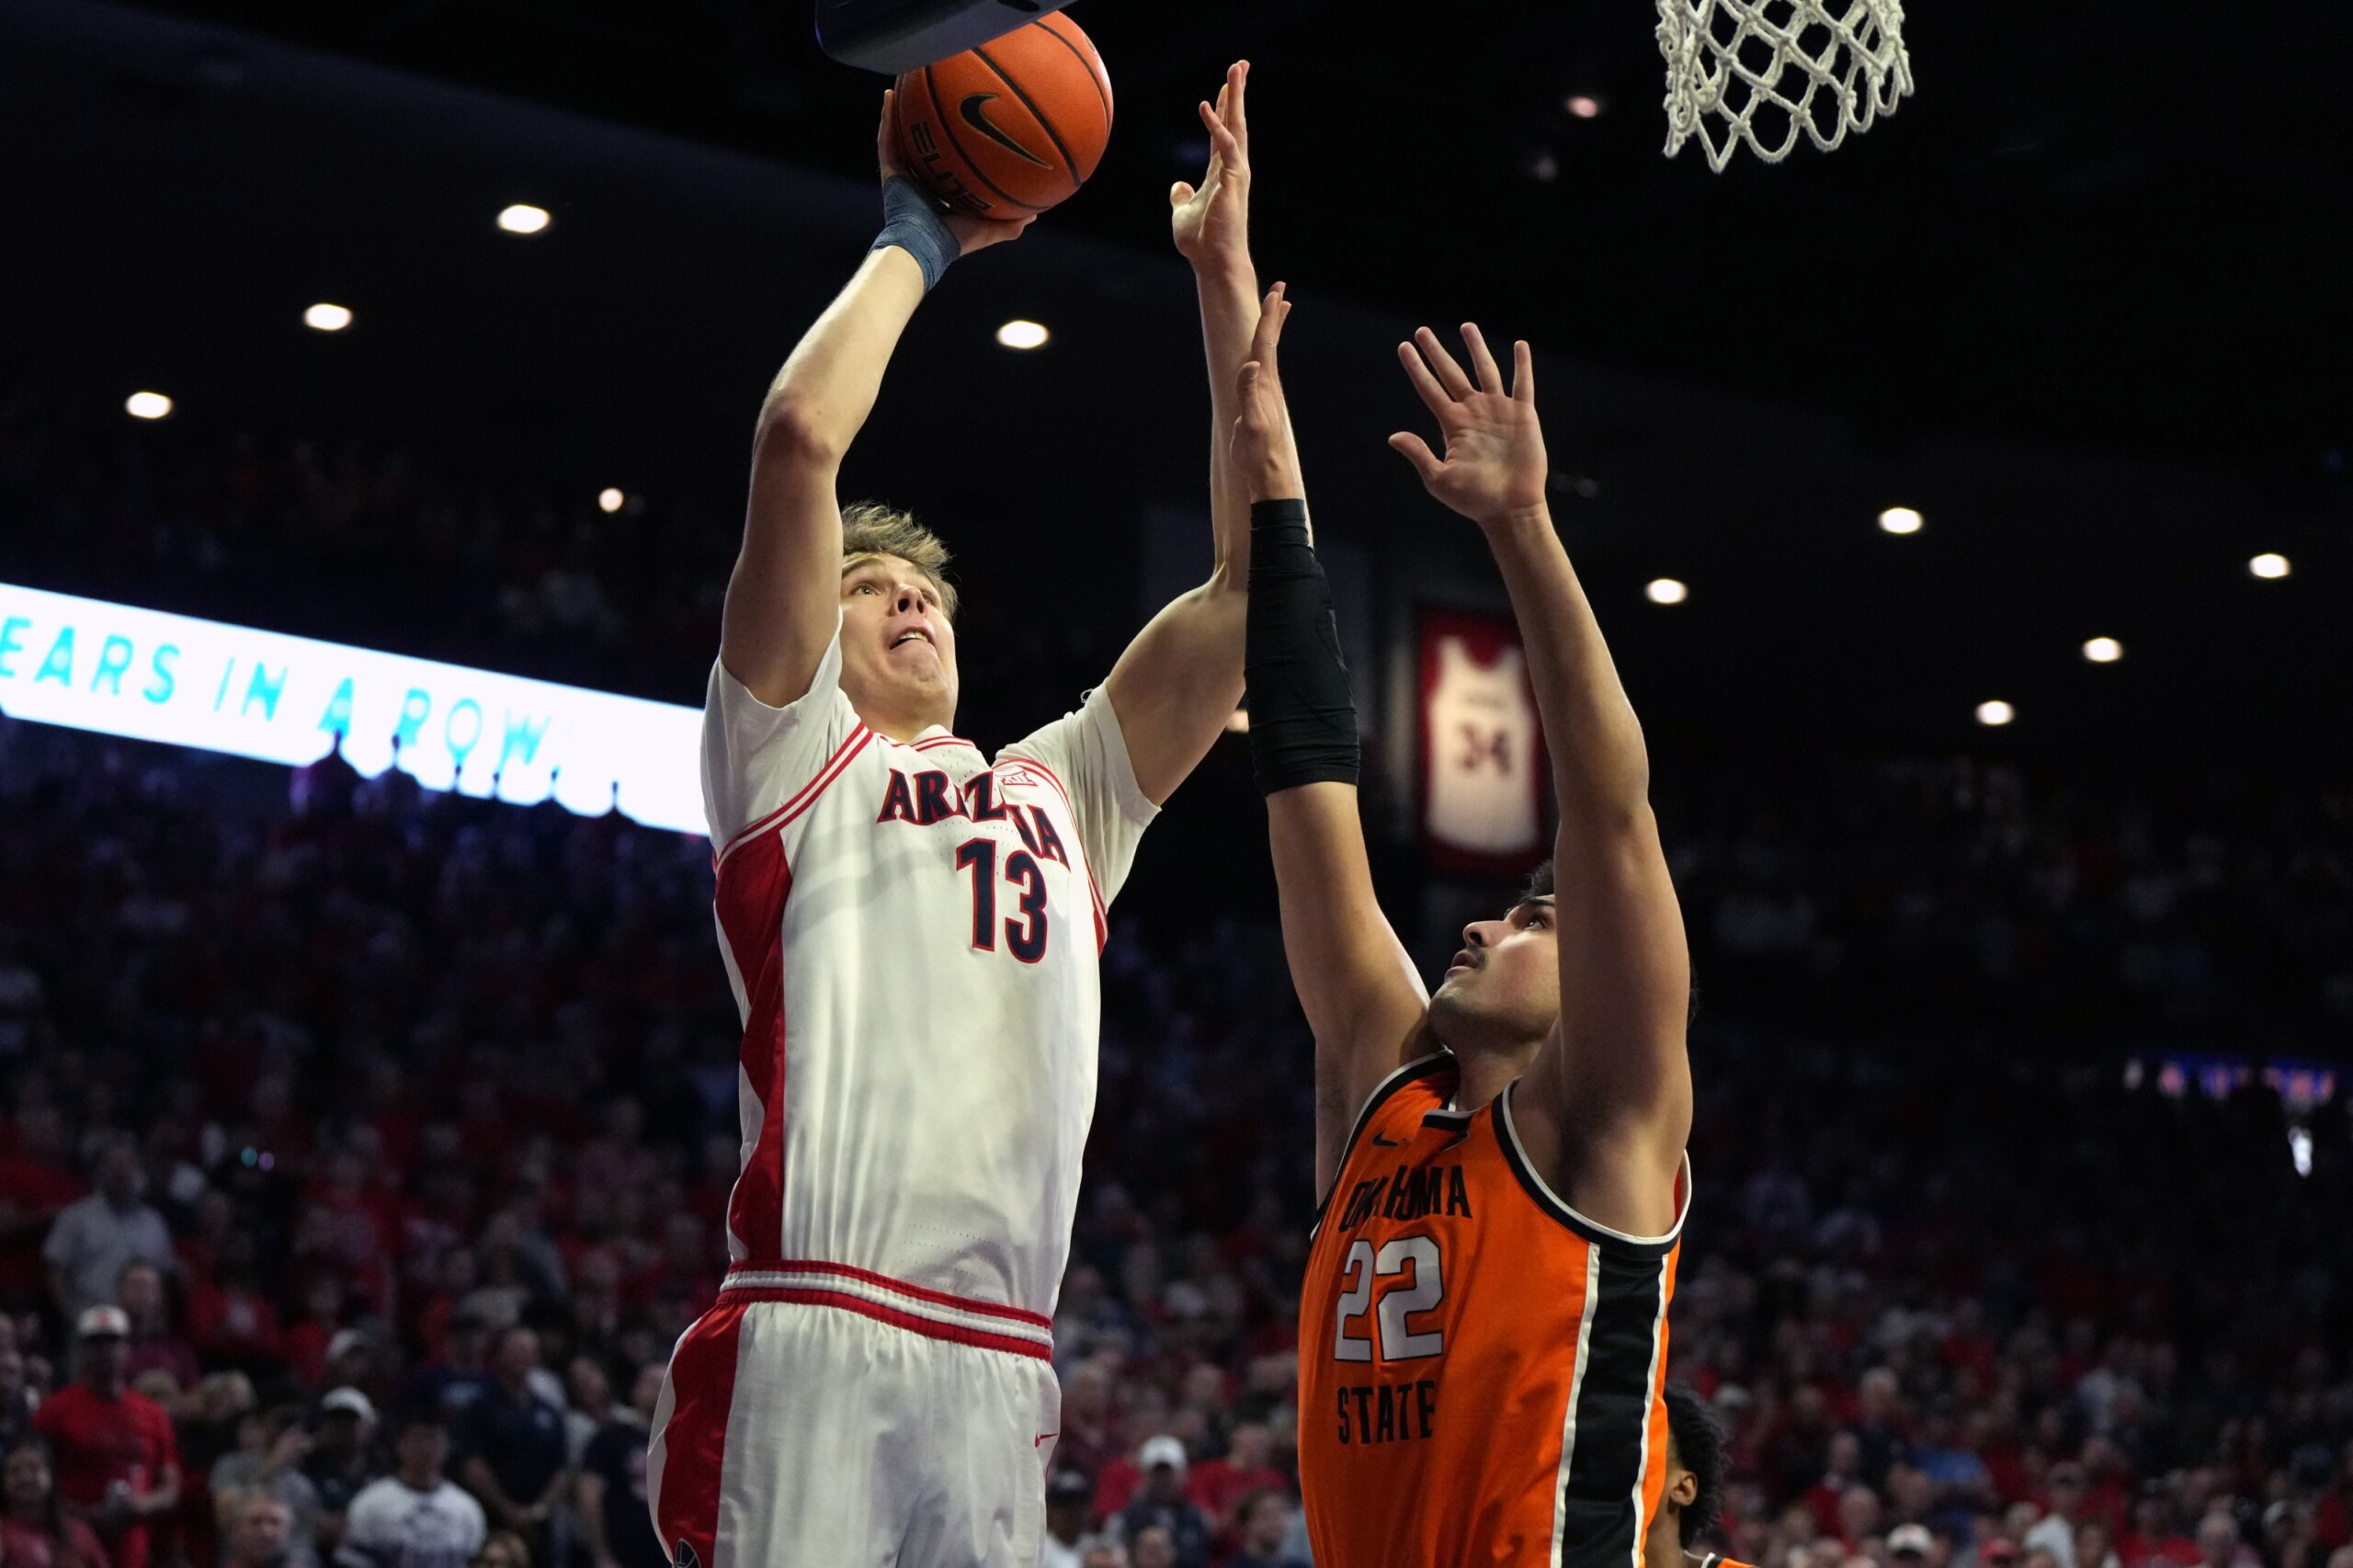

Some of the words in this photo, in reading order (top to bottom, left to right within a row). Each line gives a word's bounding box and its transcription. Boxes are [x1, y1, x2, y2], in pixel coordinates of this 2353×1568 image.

[0, 615, 181, 705] EARS
[212, 655, 289, 722] IN
[316, 676, 355, 738] A
[956, 837, 1048, 963] 13
[1333, 1234, 1445, 1362] 22
[1337, 1380, 1437, 1445] STATE
